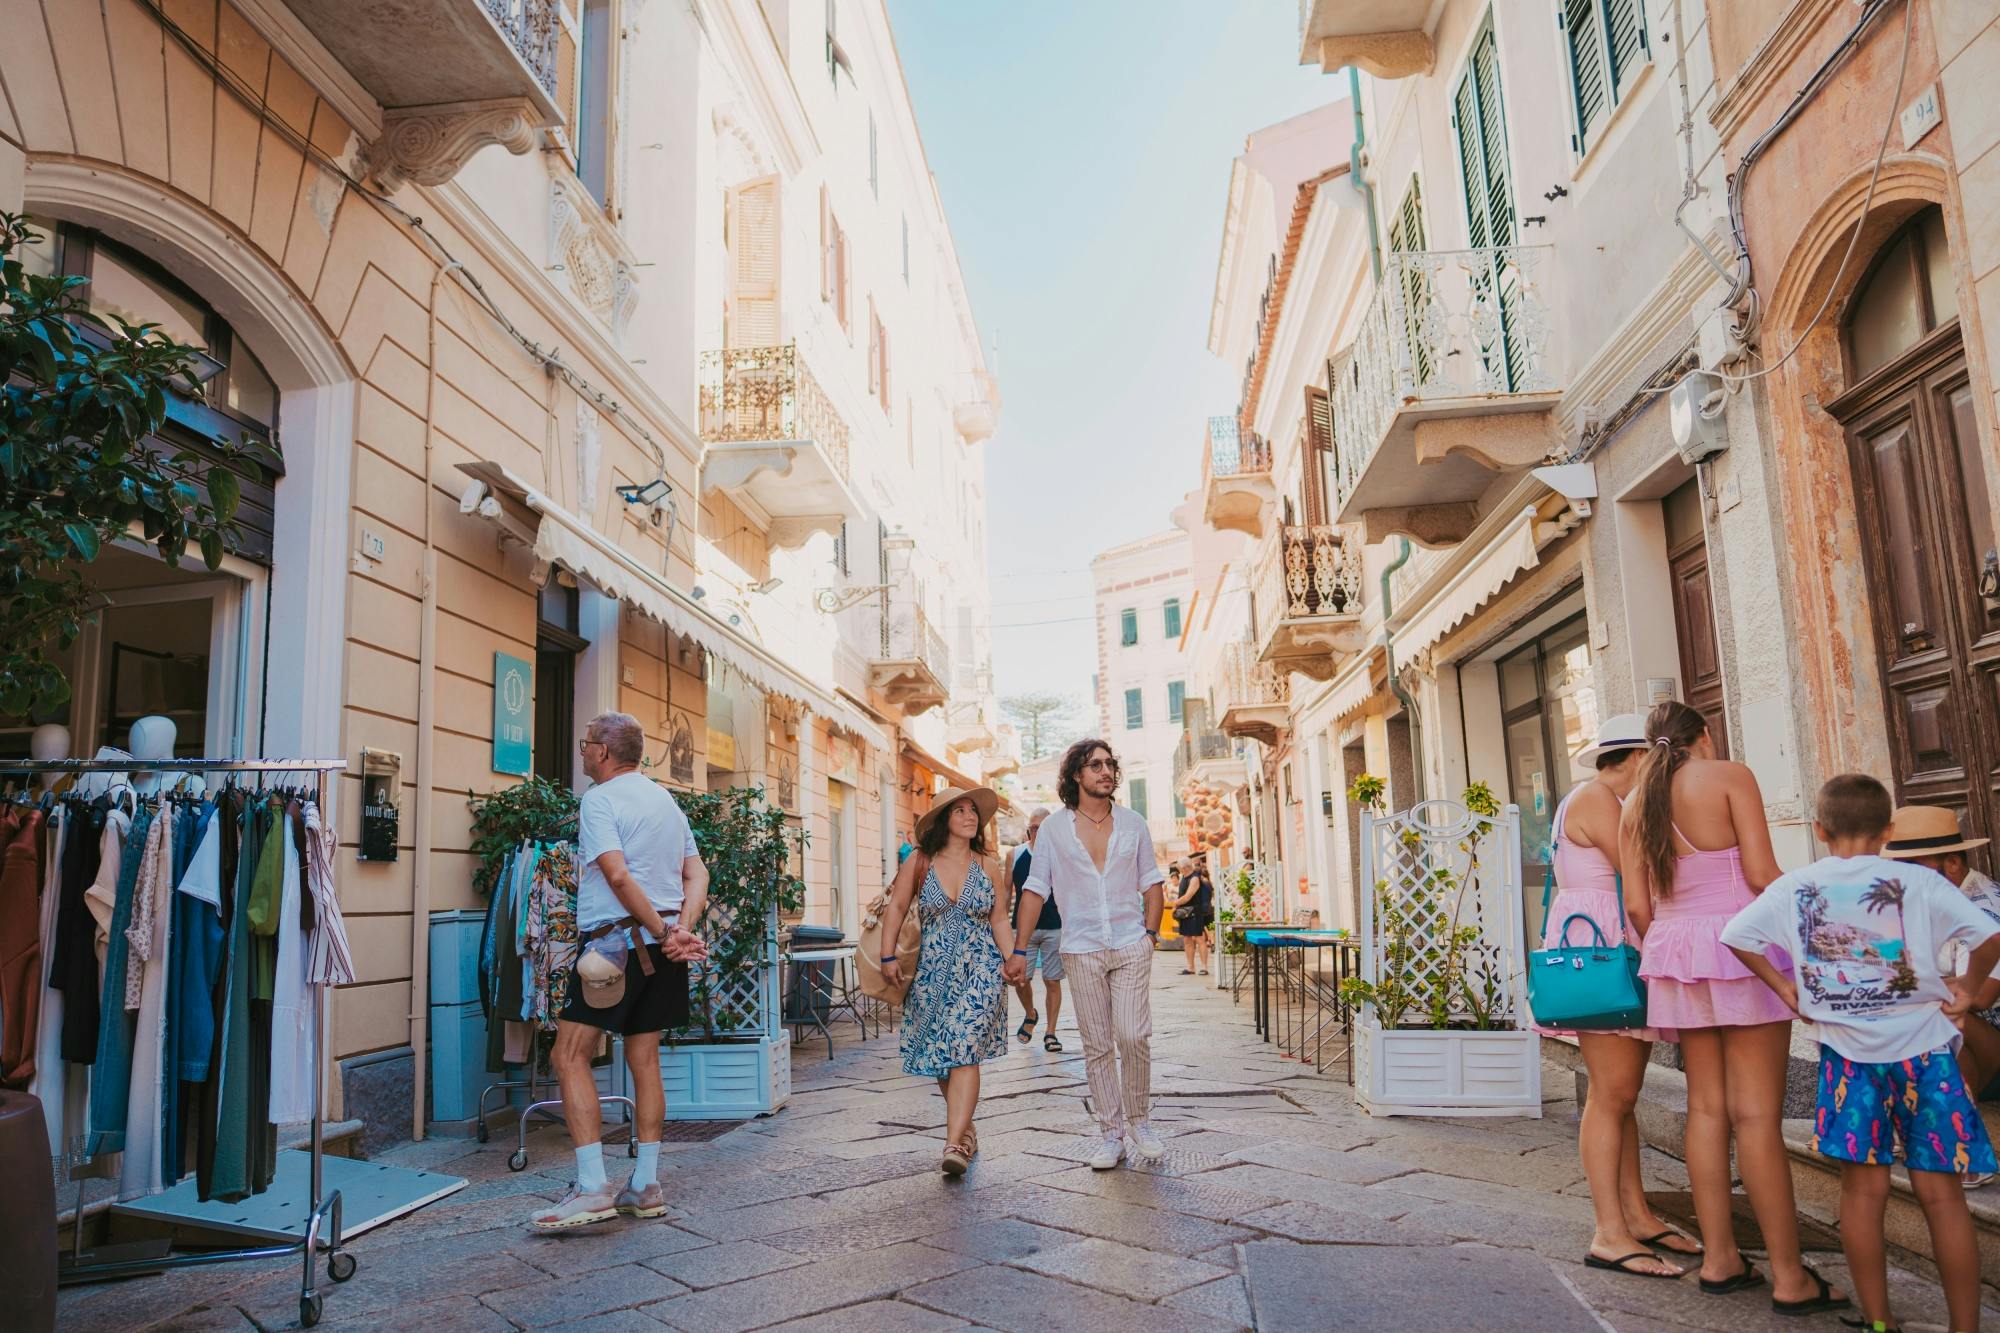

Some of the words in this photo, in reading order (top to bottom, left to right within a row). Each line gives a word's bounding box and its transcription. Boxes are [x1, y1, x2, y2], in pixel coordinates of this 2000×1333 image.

[1916, 94, 1934, 120] 94
[373, 538, 383, 554] 73
[366, 805, 382, 818] DAVID
[1811, 986, 1855, 1005] Grand
[1855, 986, 1893, 1001] Hotel
